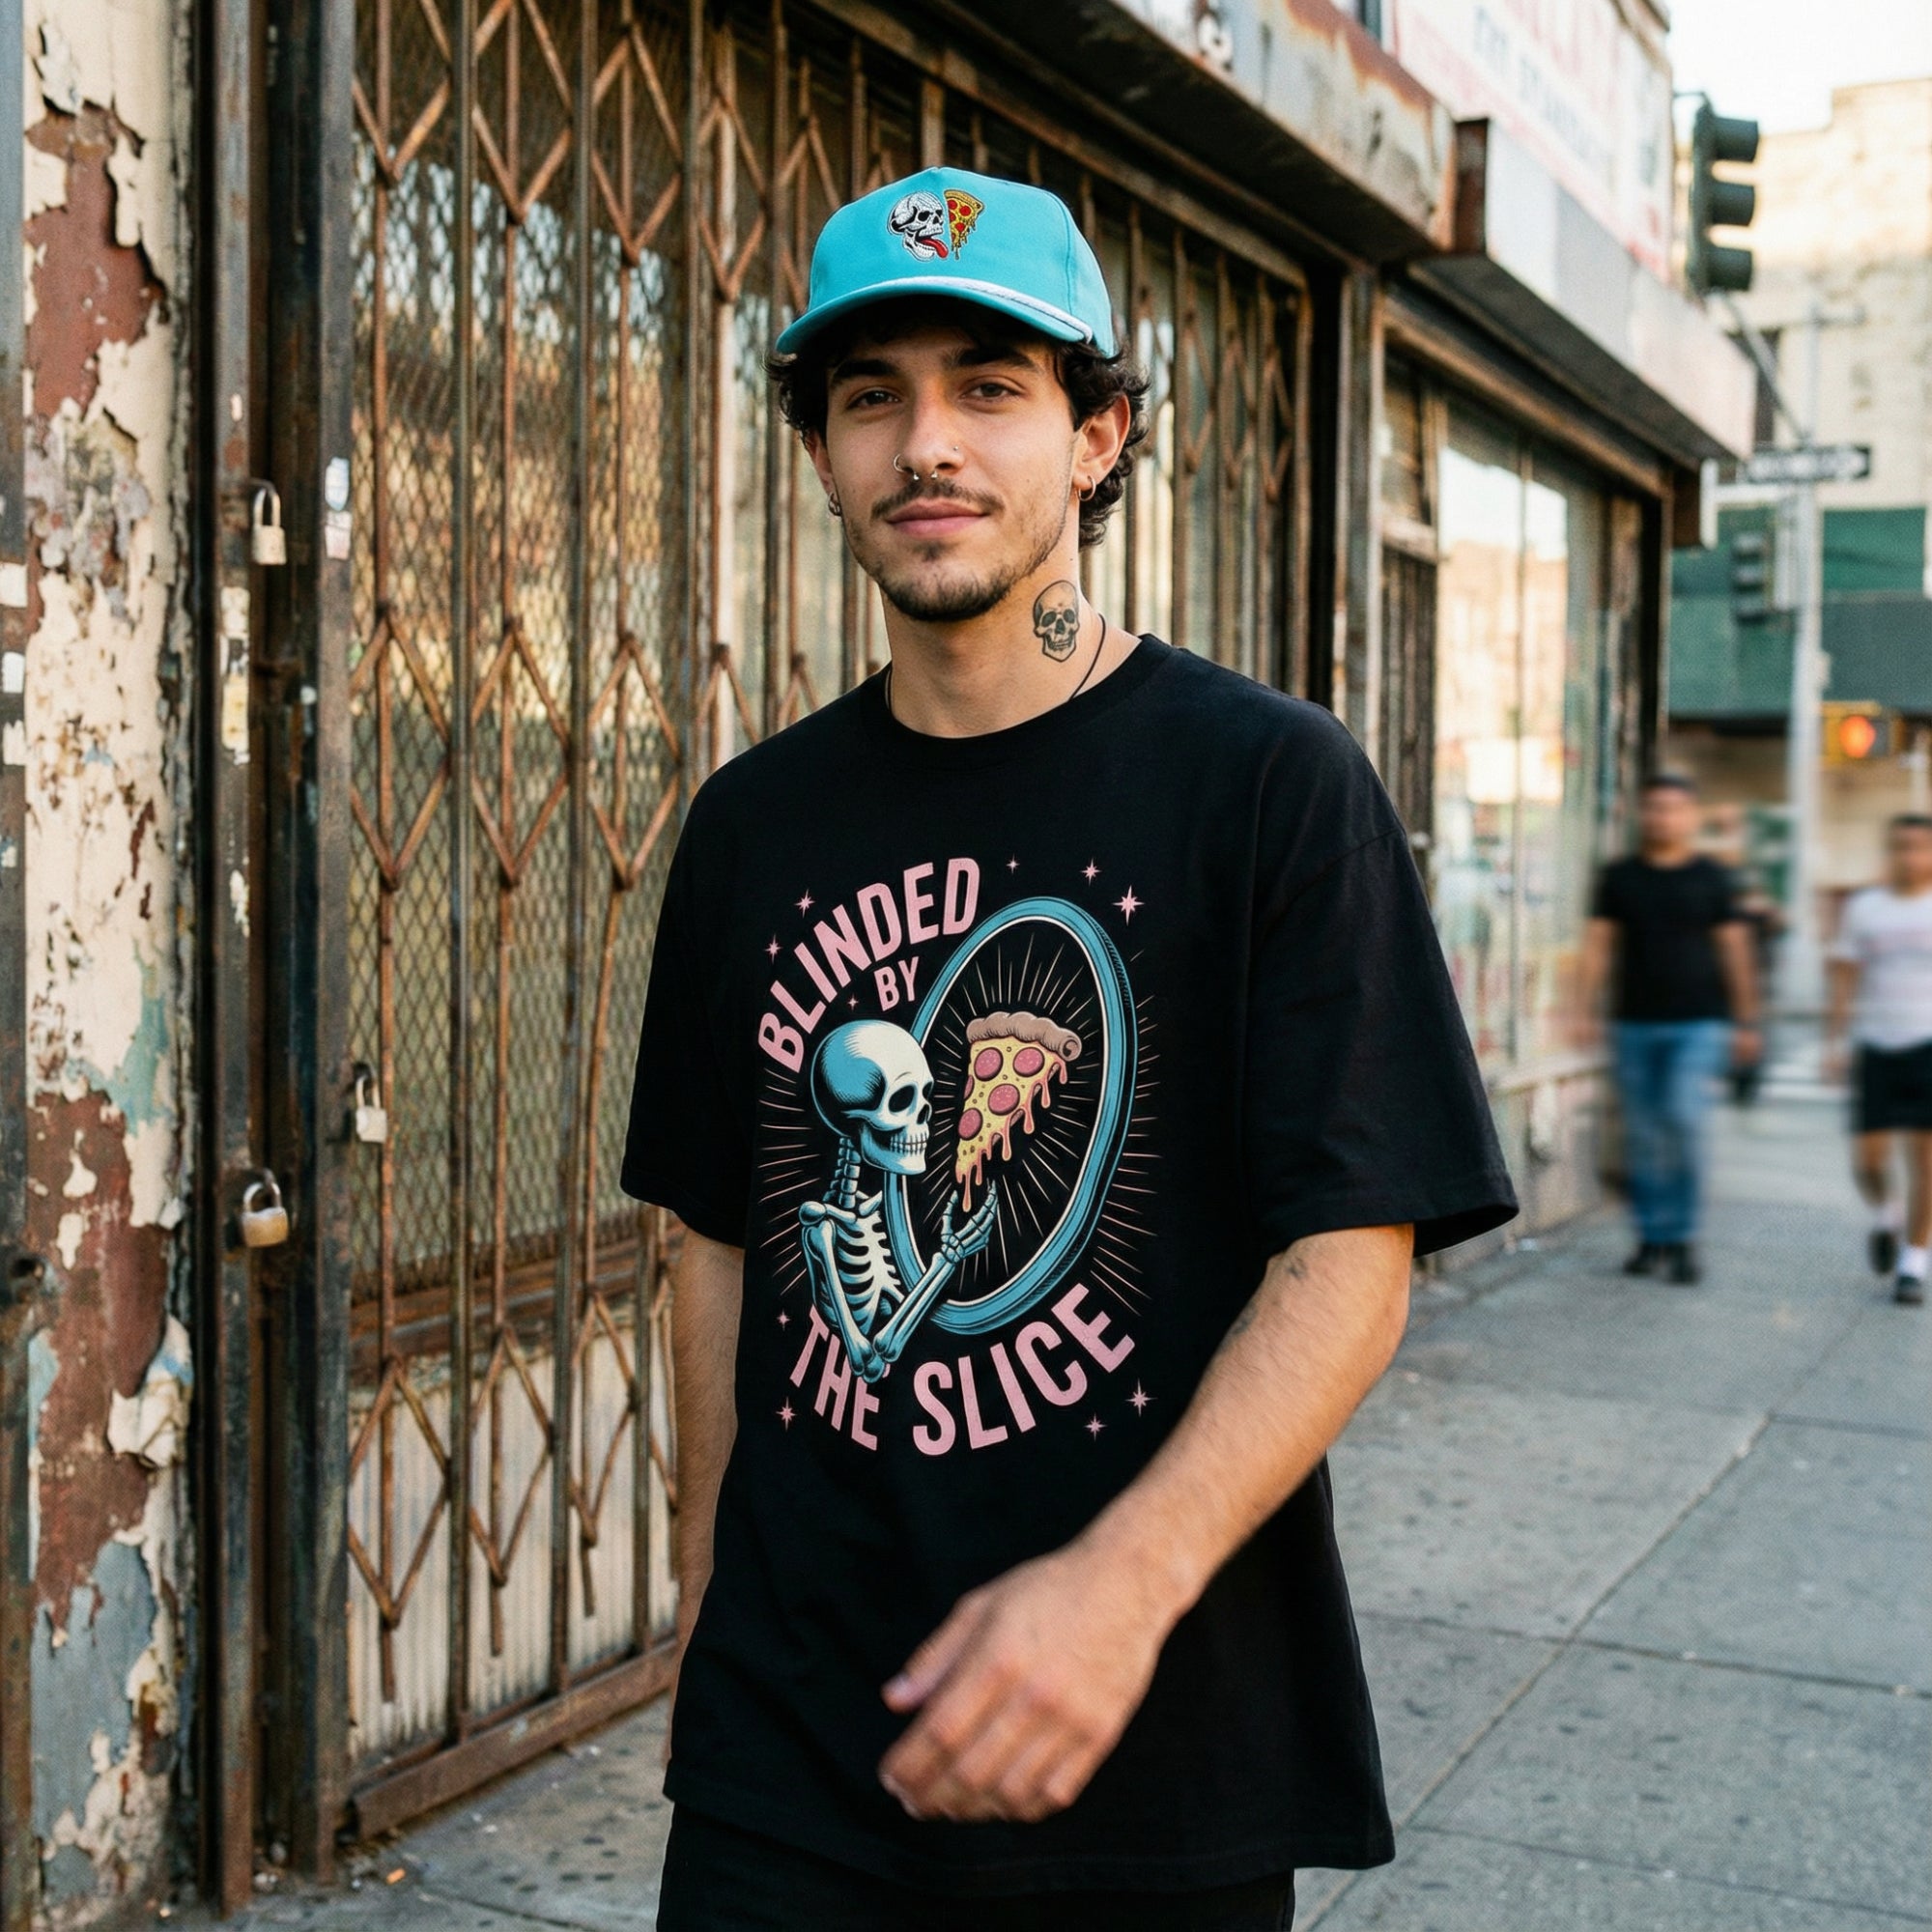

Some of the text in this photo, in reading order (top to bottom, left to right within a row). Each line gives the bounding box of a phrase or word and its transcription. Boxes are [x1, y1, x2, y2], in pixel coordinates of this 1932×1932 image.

[757, 857, 980, 1072] BLINDED
[873, 956, 919, 1011] BY
[789, 1283, 1135, 1456] THE SLICE
